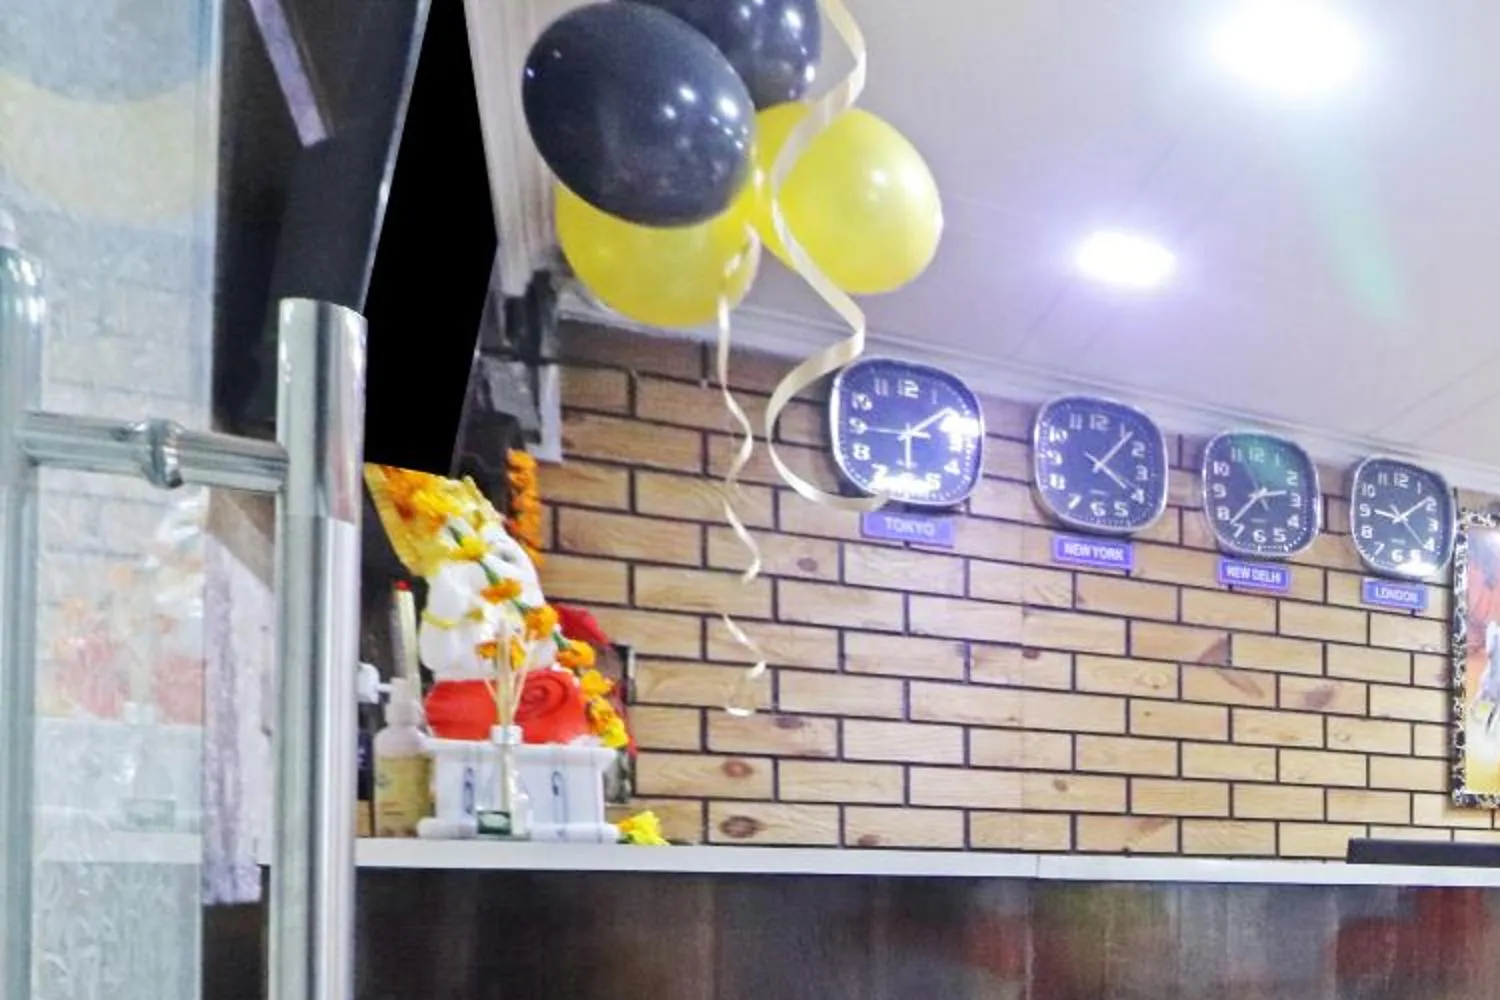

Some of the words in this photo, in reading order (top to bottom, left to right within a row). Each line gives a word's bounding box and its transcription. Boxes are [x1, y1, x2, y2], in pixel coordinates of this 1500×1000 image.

[897, 380, 920, 398] 12
[1069, 414, 1082, 430] 11
[1089, 414, 1110, 431] 12
[1049, 426, 1068, 443] 10
[852, 444, 871, 460] 8
[1131, 442, 1146, 458] 2
[1231, 448, 1242, 462] 11
[1248, 448, 1264, 462] 12
[944, 460, 960, 474] 4
[1135, 465, 1148, 481] 3
[1213, 462, 1230, 476] 10
[1286, 470, 1298, 484] 2
[1377, 473, 1387, 485] 11
[1394, 473, 1409, 488] 12
[1130, 489, 1145, 504] 4
[1212, 483, 1227, 498] 9
[1362, 484, 1376, 498] 10
[1068, 493, 1082, 509] 7
[1289, 494, 1301, 508] 3
[1426, 496, 1437, 512] 2
[1090, 502, 1106, 516] 6
[1113, 502, 1129, 517] 5
[1216, 507, 1230, 521] 8
[1359, 504, 1371, 516] 9
[885, 517, 935, 537] TOKYO
[1287, 514, 1299, 528] 4
[1428, 519, 1439, 532] 3
[1233, 524, 1245, 538] 7
[1253, 530, 1267, 543] 6
[1272, 528, 1287, 543] 5
[1361, 526, 1373, 538] 8
[1064, 542, 1091, 557] NEW
[1092, 545, 1124, 560] YORK
[1374, 543, 1385, 555] 7
[1424, 539, 1435, 552] 4
[1391, 550, 1404, 561] 6
[1226, 566, 1250, 580] NEW
[1251, 569, 1281, 583] DELHI
[1375, 586, 1420, 603] LONDON
